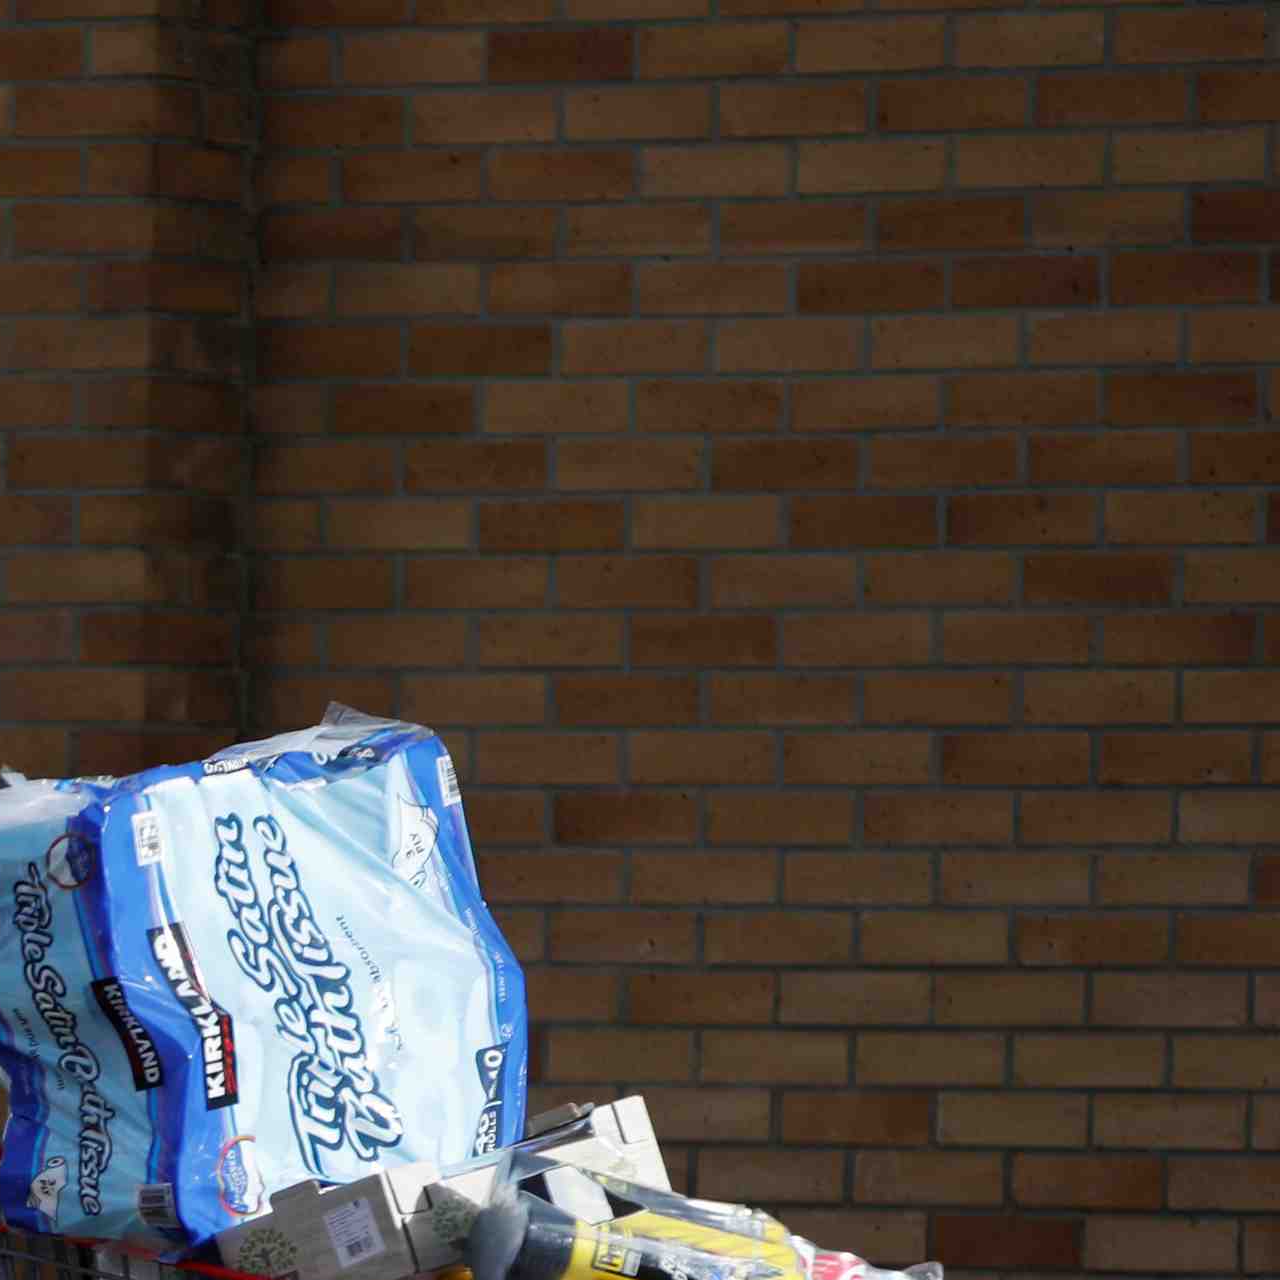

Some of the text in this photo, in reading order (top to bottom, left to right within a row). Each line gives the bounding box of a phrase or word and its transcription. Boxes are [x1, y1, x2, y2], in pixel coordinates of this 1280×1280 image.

[214, 812, 300, 1000] Satin
[253, 814, 352, 990] Tissue
[103, 983, 161, 1084] KIRKLAND
[274, 998, 344, 1178] Triple
[308, 980, 404, 1162] Bath
[79, 1124, 114, 1217] Tissue
